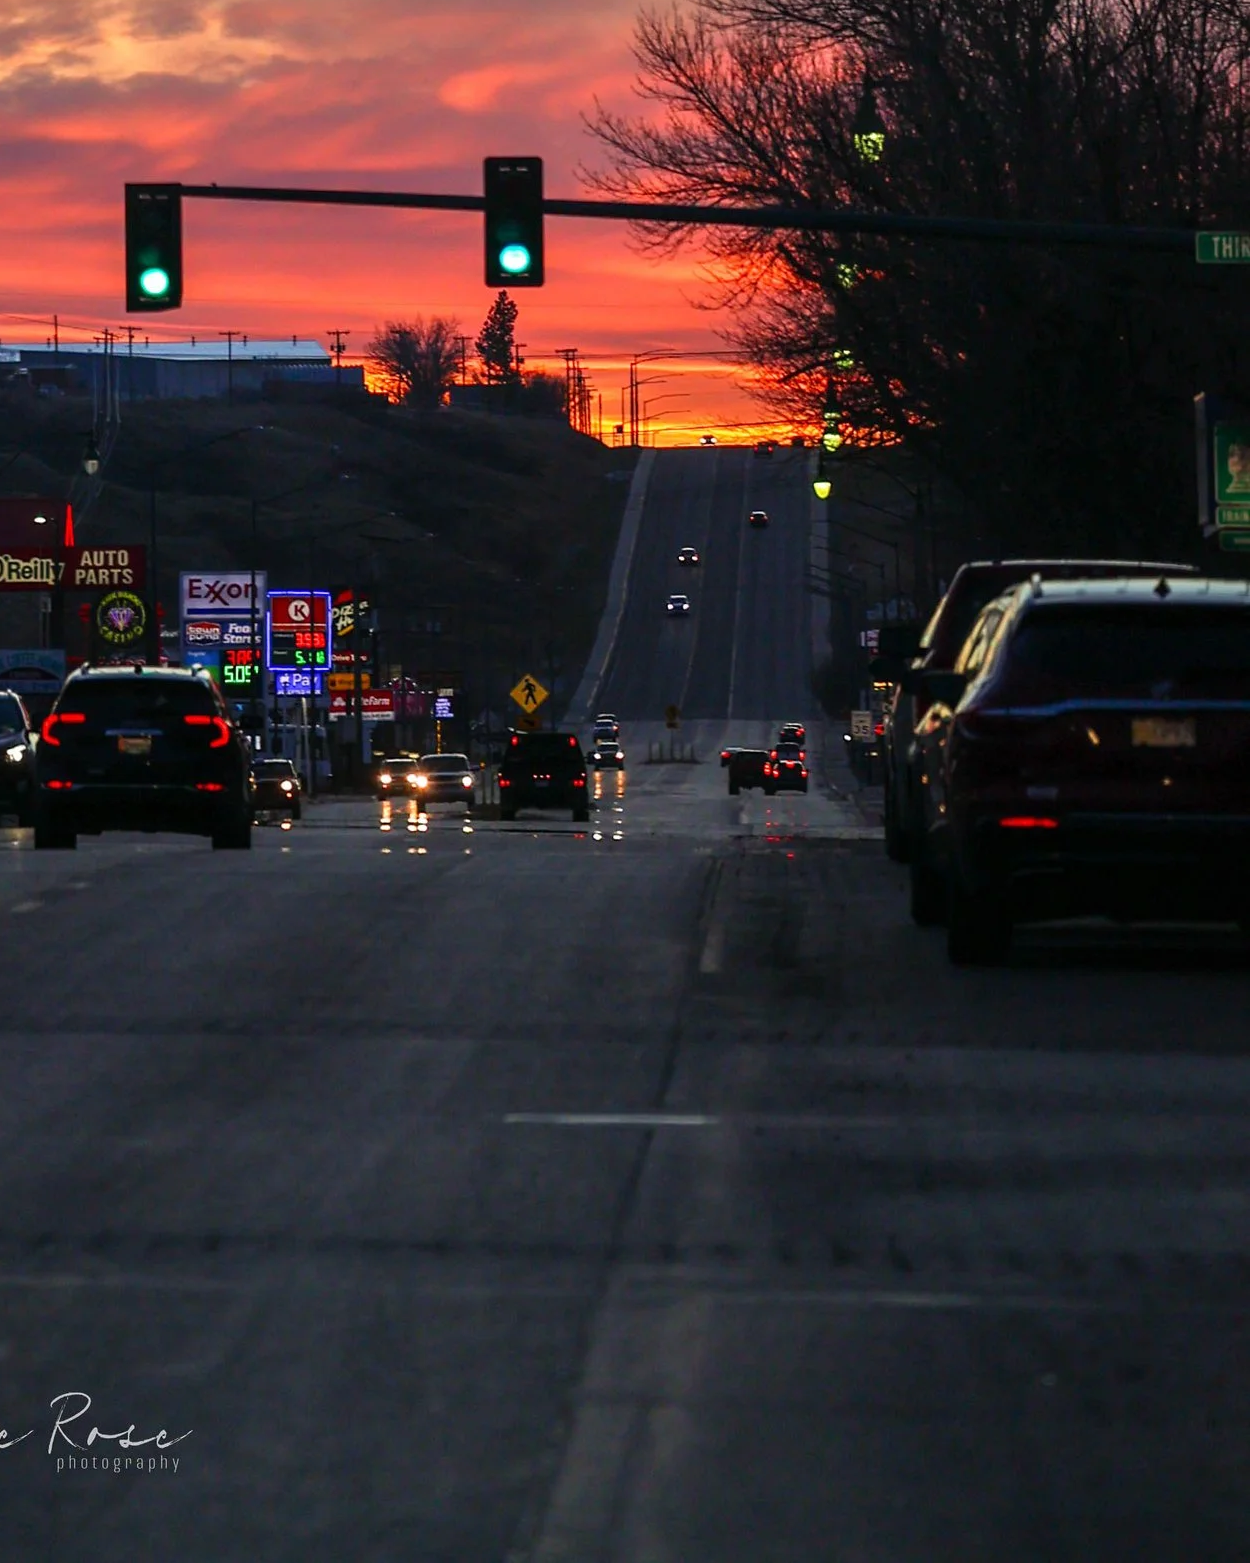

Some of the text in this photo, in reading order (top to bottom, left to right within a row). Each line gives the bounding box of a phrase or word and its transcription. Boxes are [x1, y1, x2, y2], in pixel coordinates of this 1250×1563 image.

[1212, 236, 1250, 259] THIR
[80, 549, 129, 567] AUTO
[75, 568, 134, 585] PARTS
[188, 578, 258, 606] Exxon
